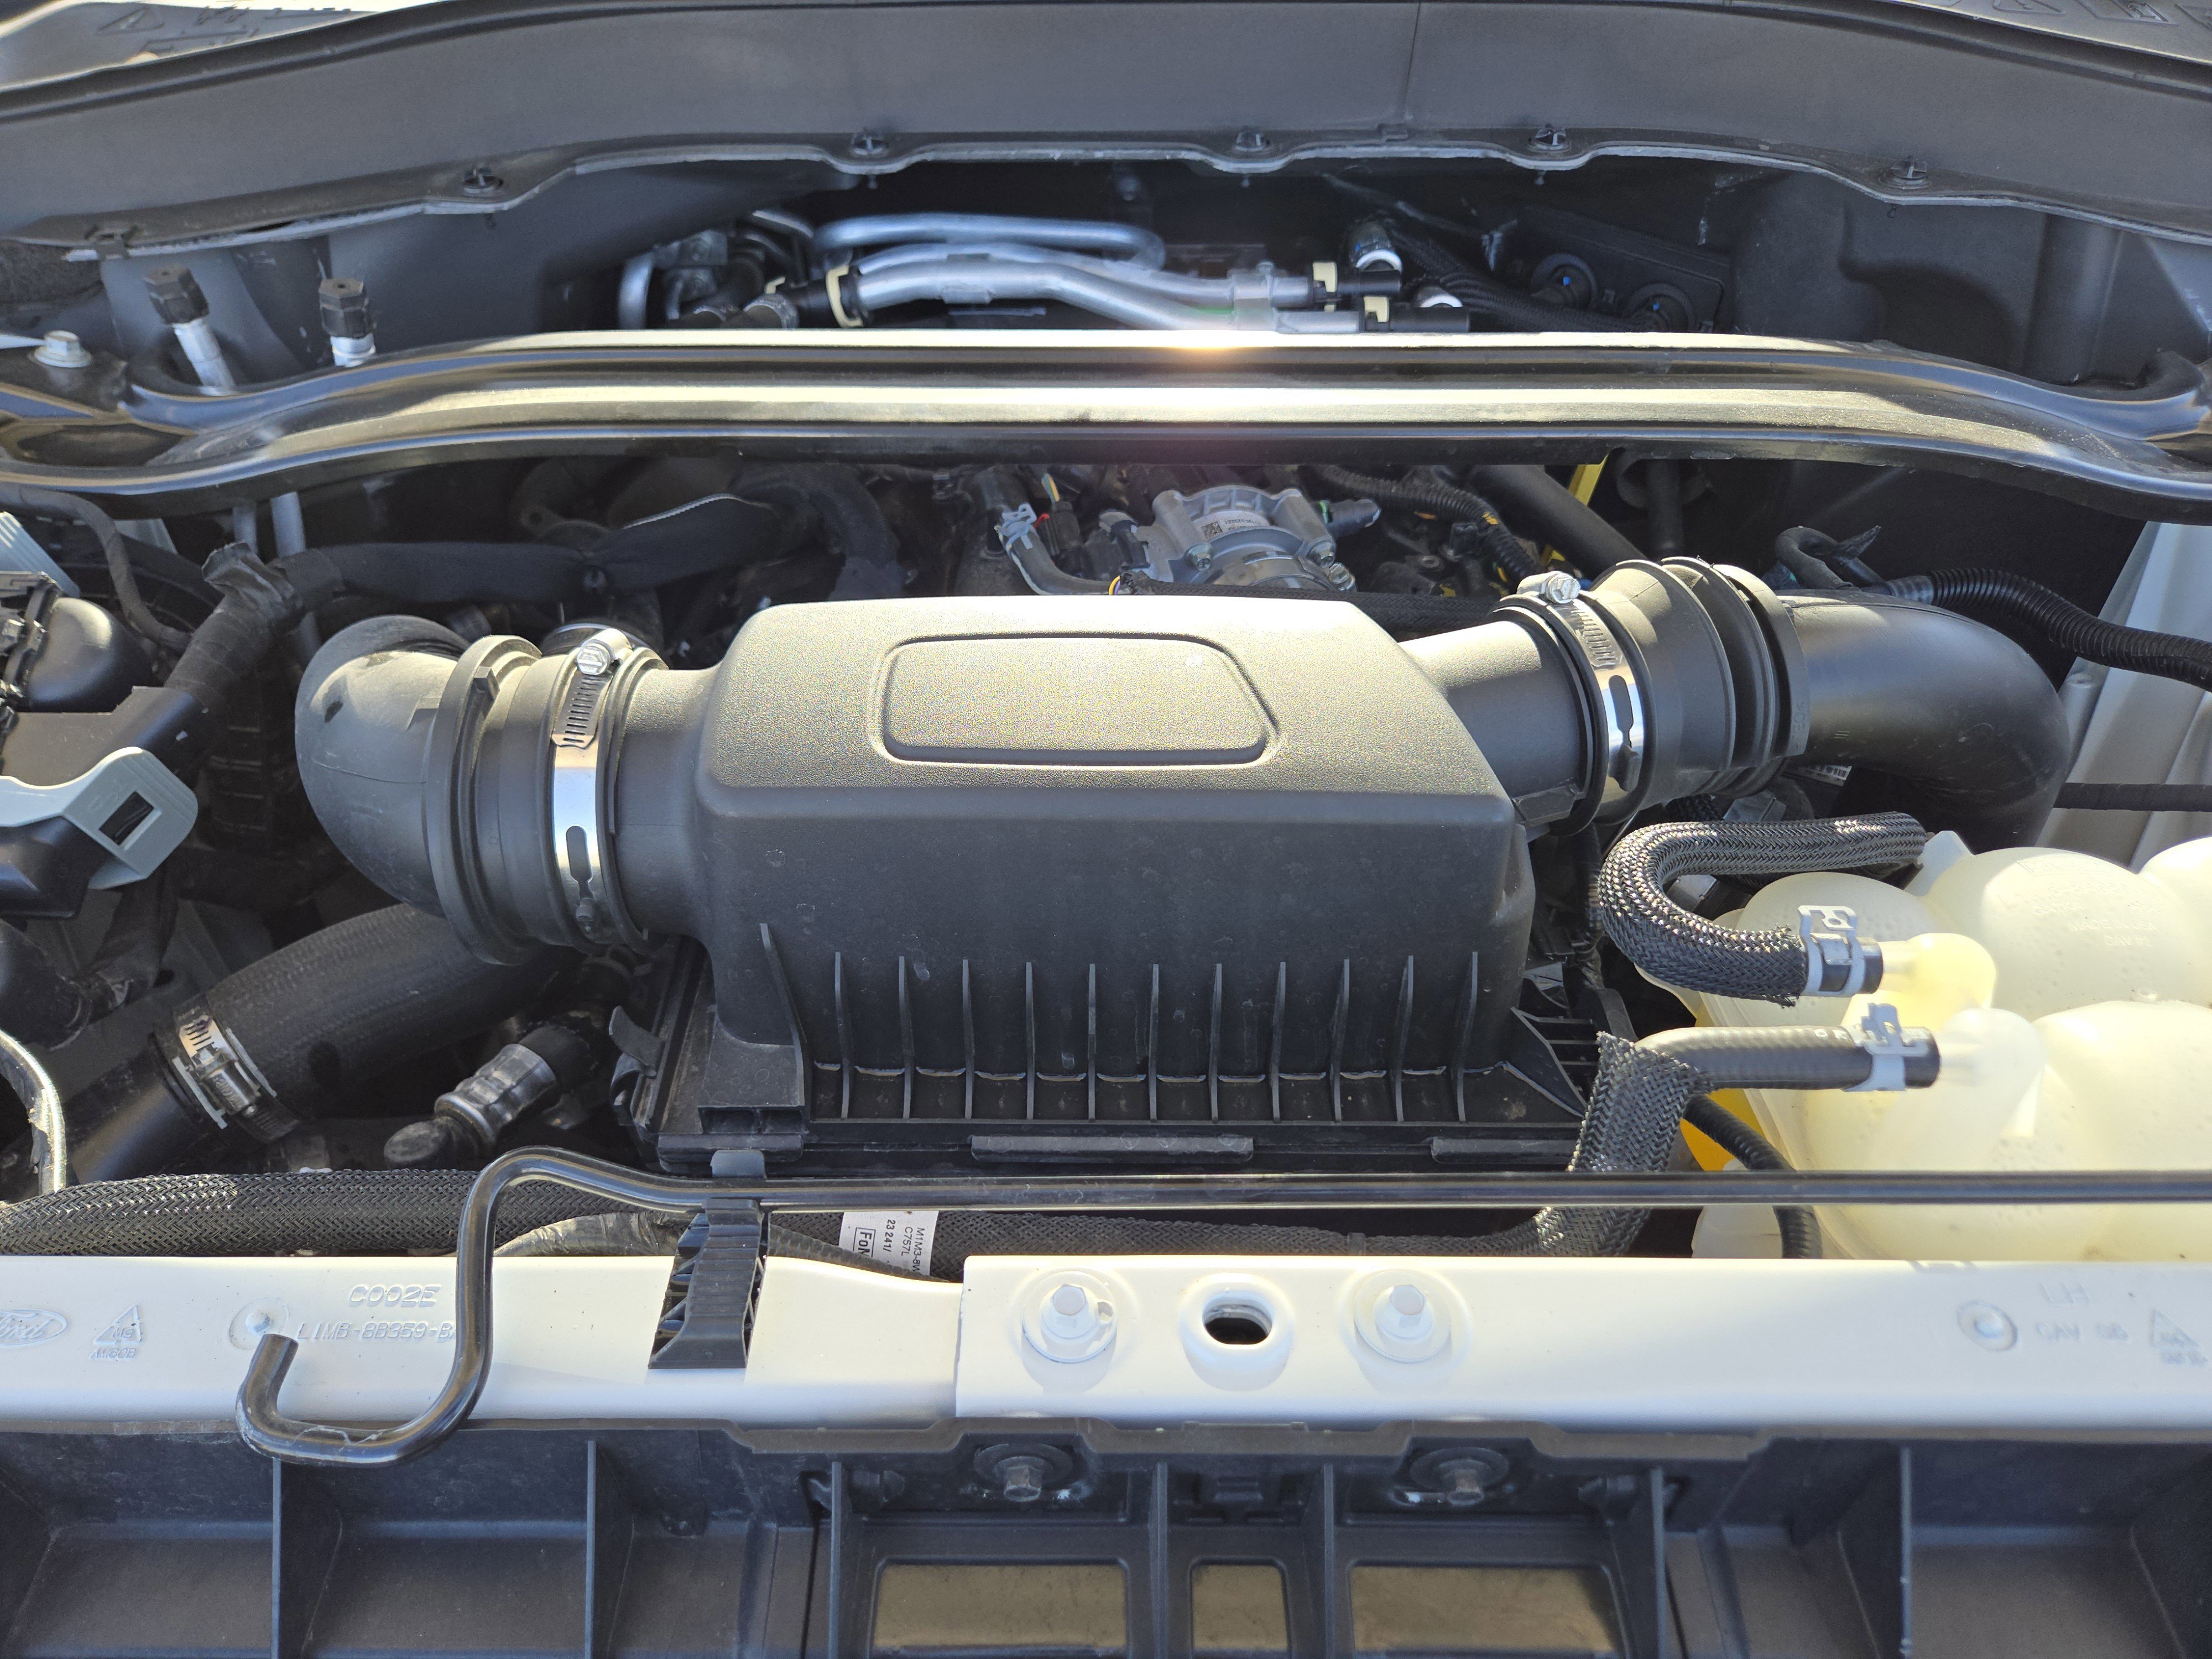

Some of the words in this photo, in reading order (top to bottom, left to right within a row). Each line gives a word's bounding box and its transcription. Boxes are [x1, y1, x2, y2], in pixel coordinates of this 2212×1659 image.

[2068, 919, 2113, 931] MADE
[886, 1219, 896, 1230] 23
[901, 1227, 912, 1256] C757L
